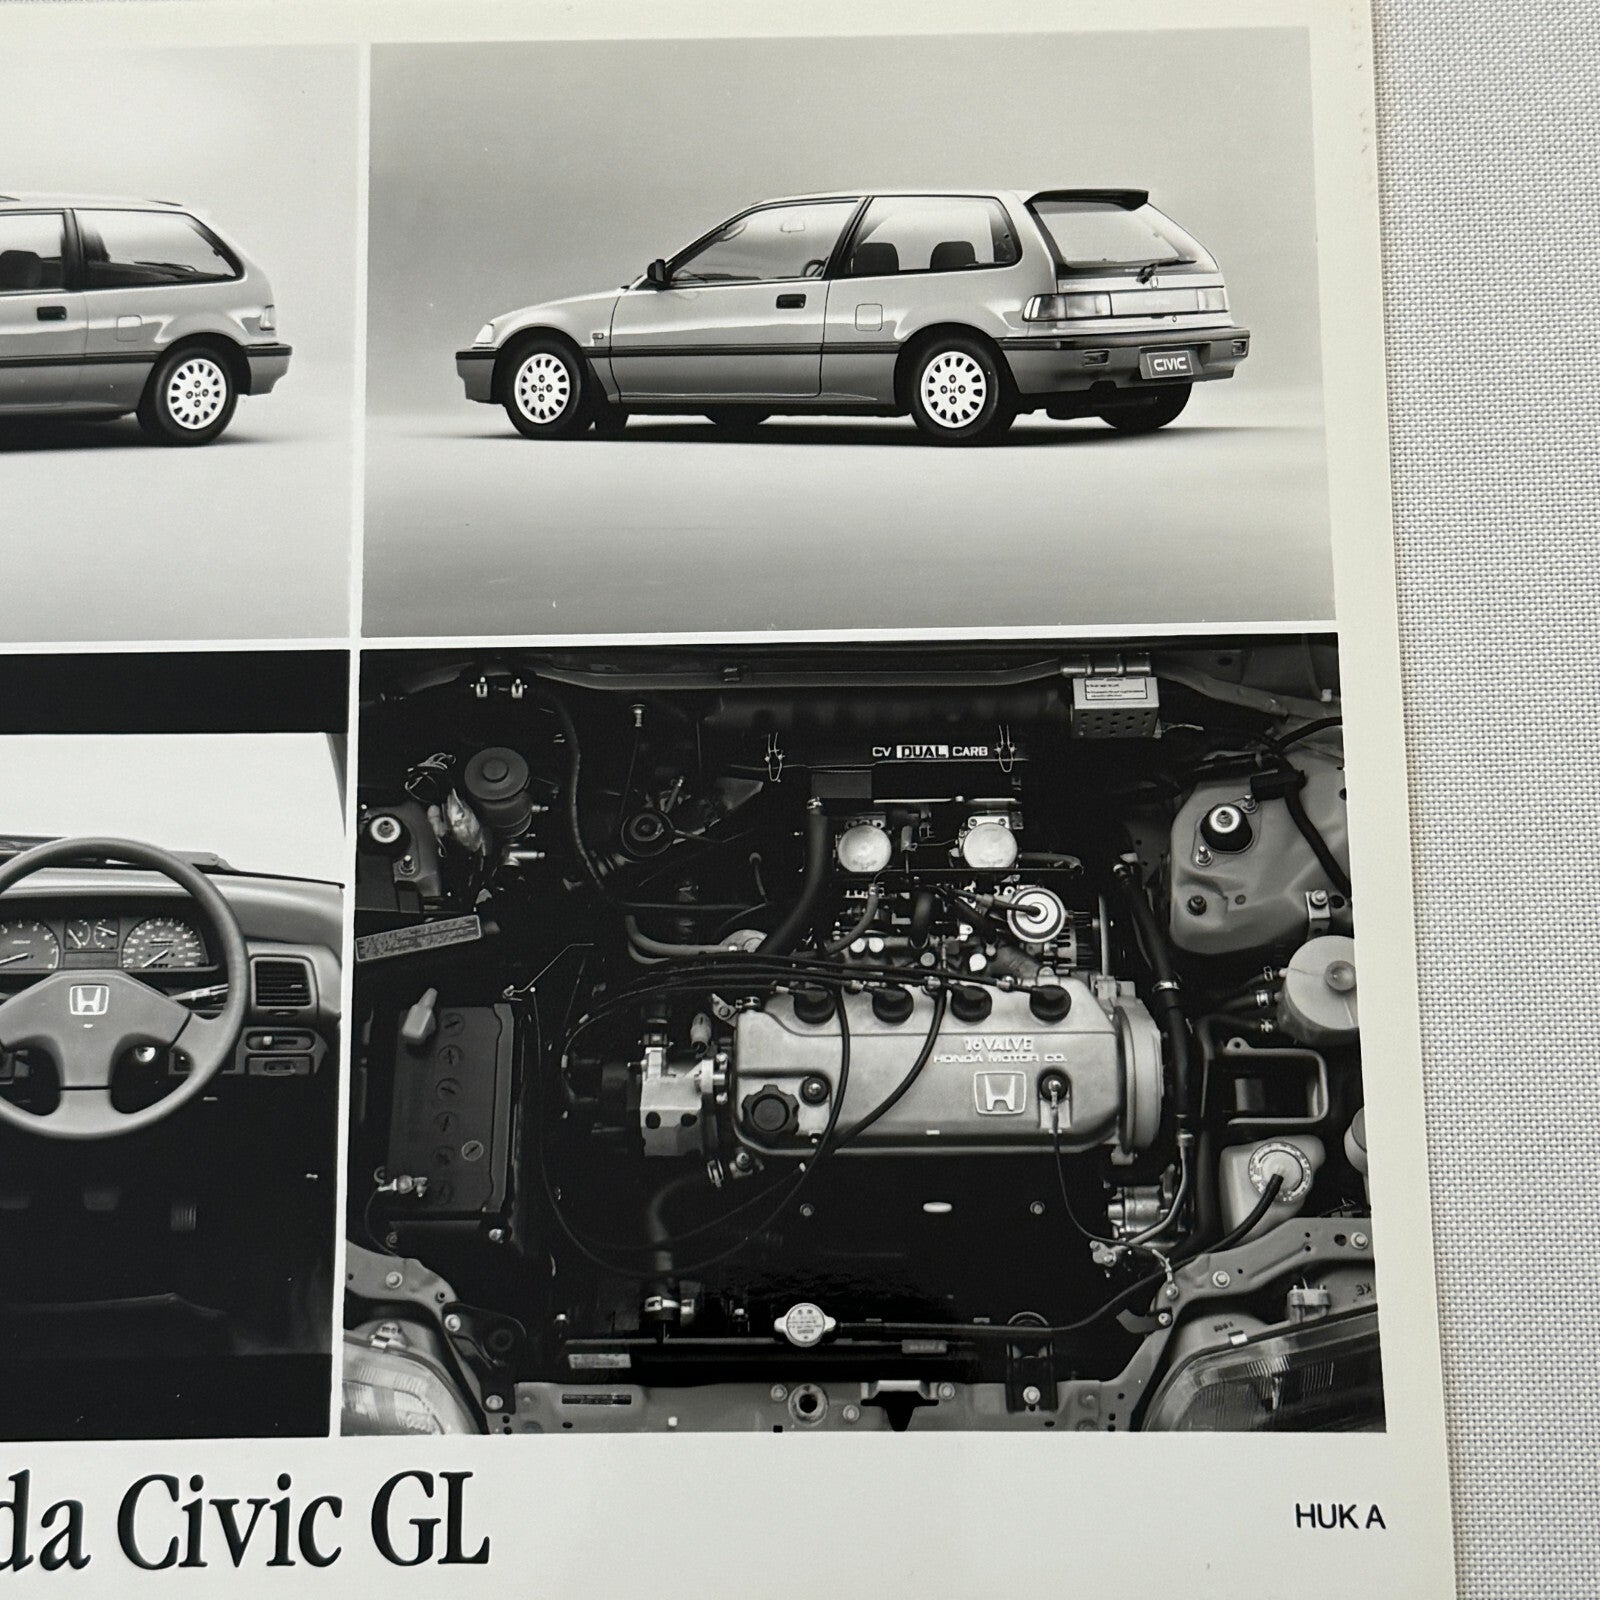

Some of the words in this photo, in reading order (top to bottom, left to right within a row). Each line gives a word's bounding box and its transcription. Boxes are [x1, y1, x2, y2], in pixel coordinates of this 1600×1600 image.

[1153, 356, 1188, 371] CIVIC
[872, 746, 892, 757] CV
[899, 745, 948, 758] DUAL
[952, 746, 989, 757] CARB
[933, 1054, 983, 1063] HONDA
[988, 1054, 1039, 1063] MOTOR
[117, 1473, 342, 1571] Civic
[371, 1470, 489, 1567] GL
